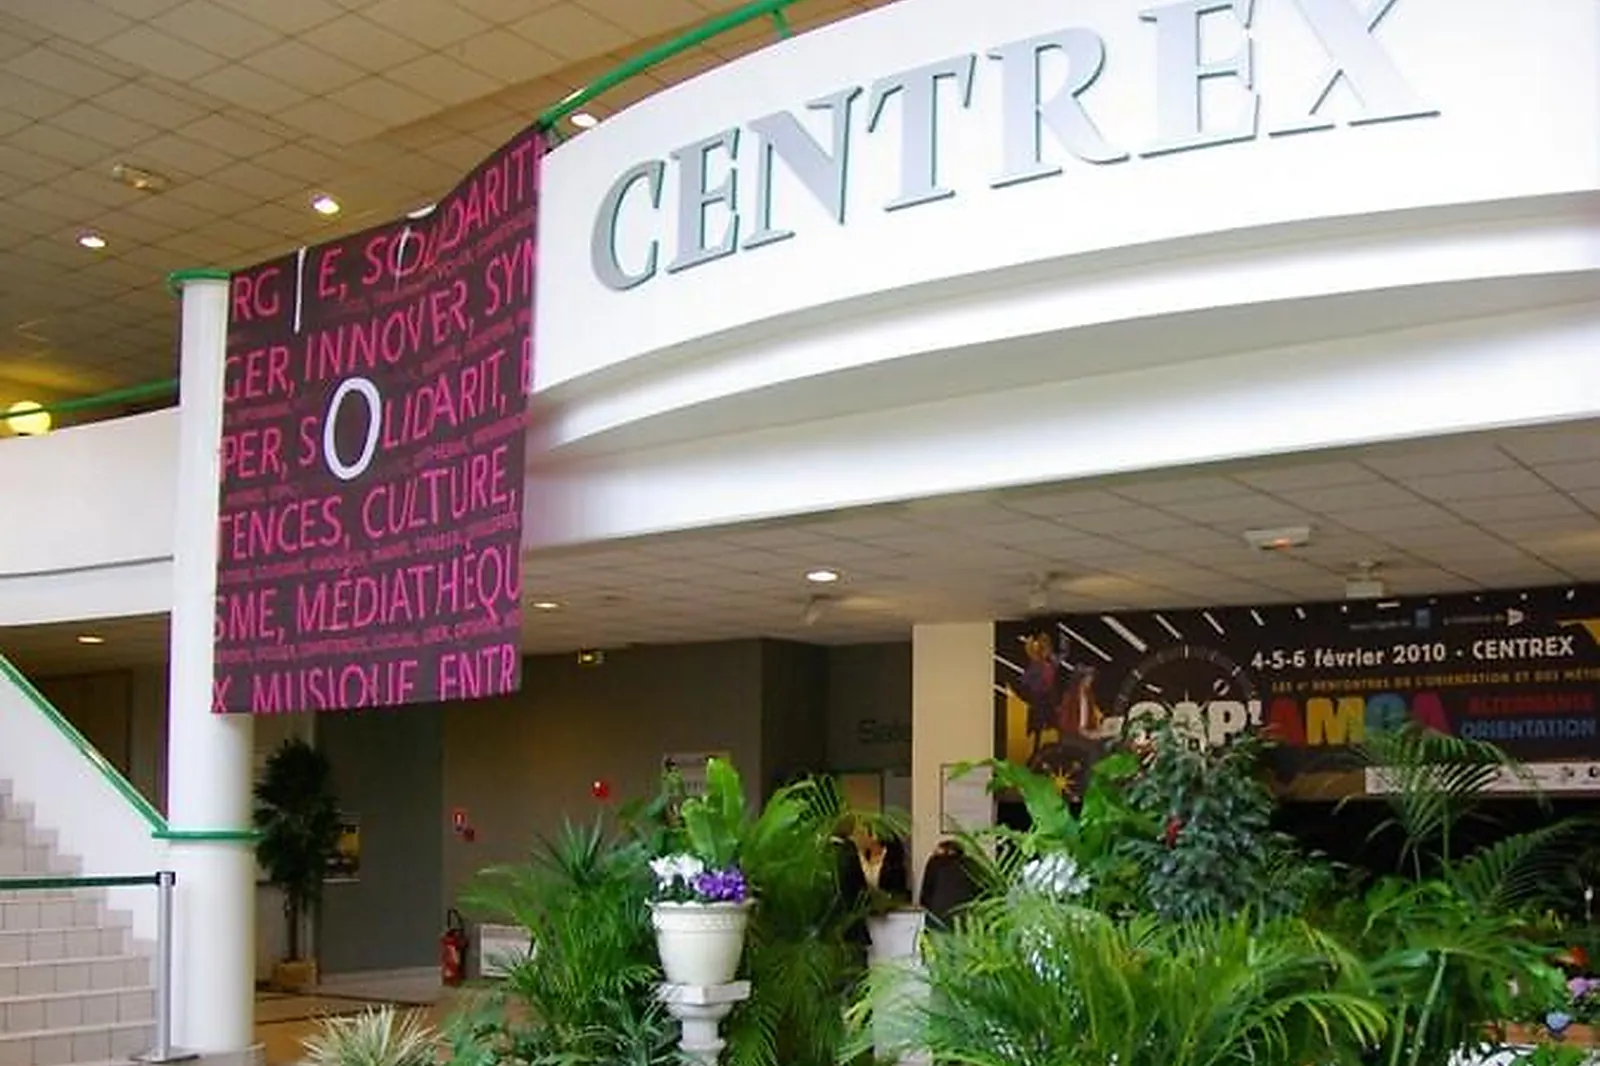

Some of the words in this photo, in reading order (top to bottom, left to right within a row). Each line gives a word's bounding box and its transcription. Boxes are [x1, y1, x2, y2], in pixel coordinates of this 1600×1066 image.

[590, 0, 1441, 291] CENTREX
[304, 279, 475, 380] INNOVER,
[220, 427, 288, 481] PER,
[362, 445, 516, 539] CULTURE,
[1251, 650, 1306, 670] 4-5-6
[1313, 647, 1385, 668] février
[1393, 643, 1446, 664] 2010
[1472, 635, 1574, 660] CENTREX
[1460, 717, 1596, 739] ORIENTATION
